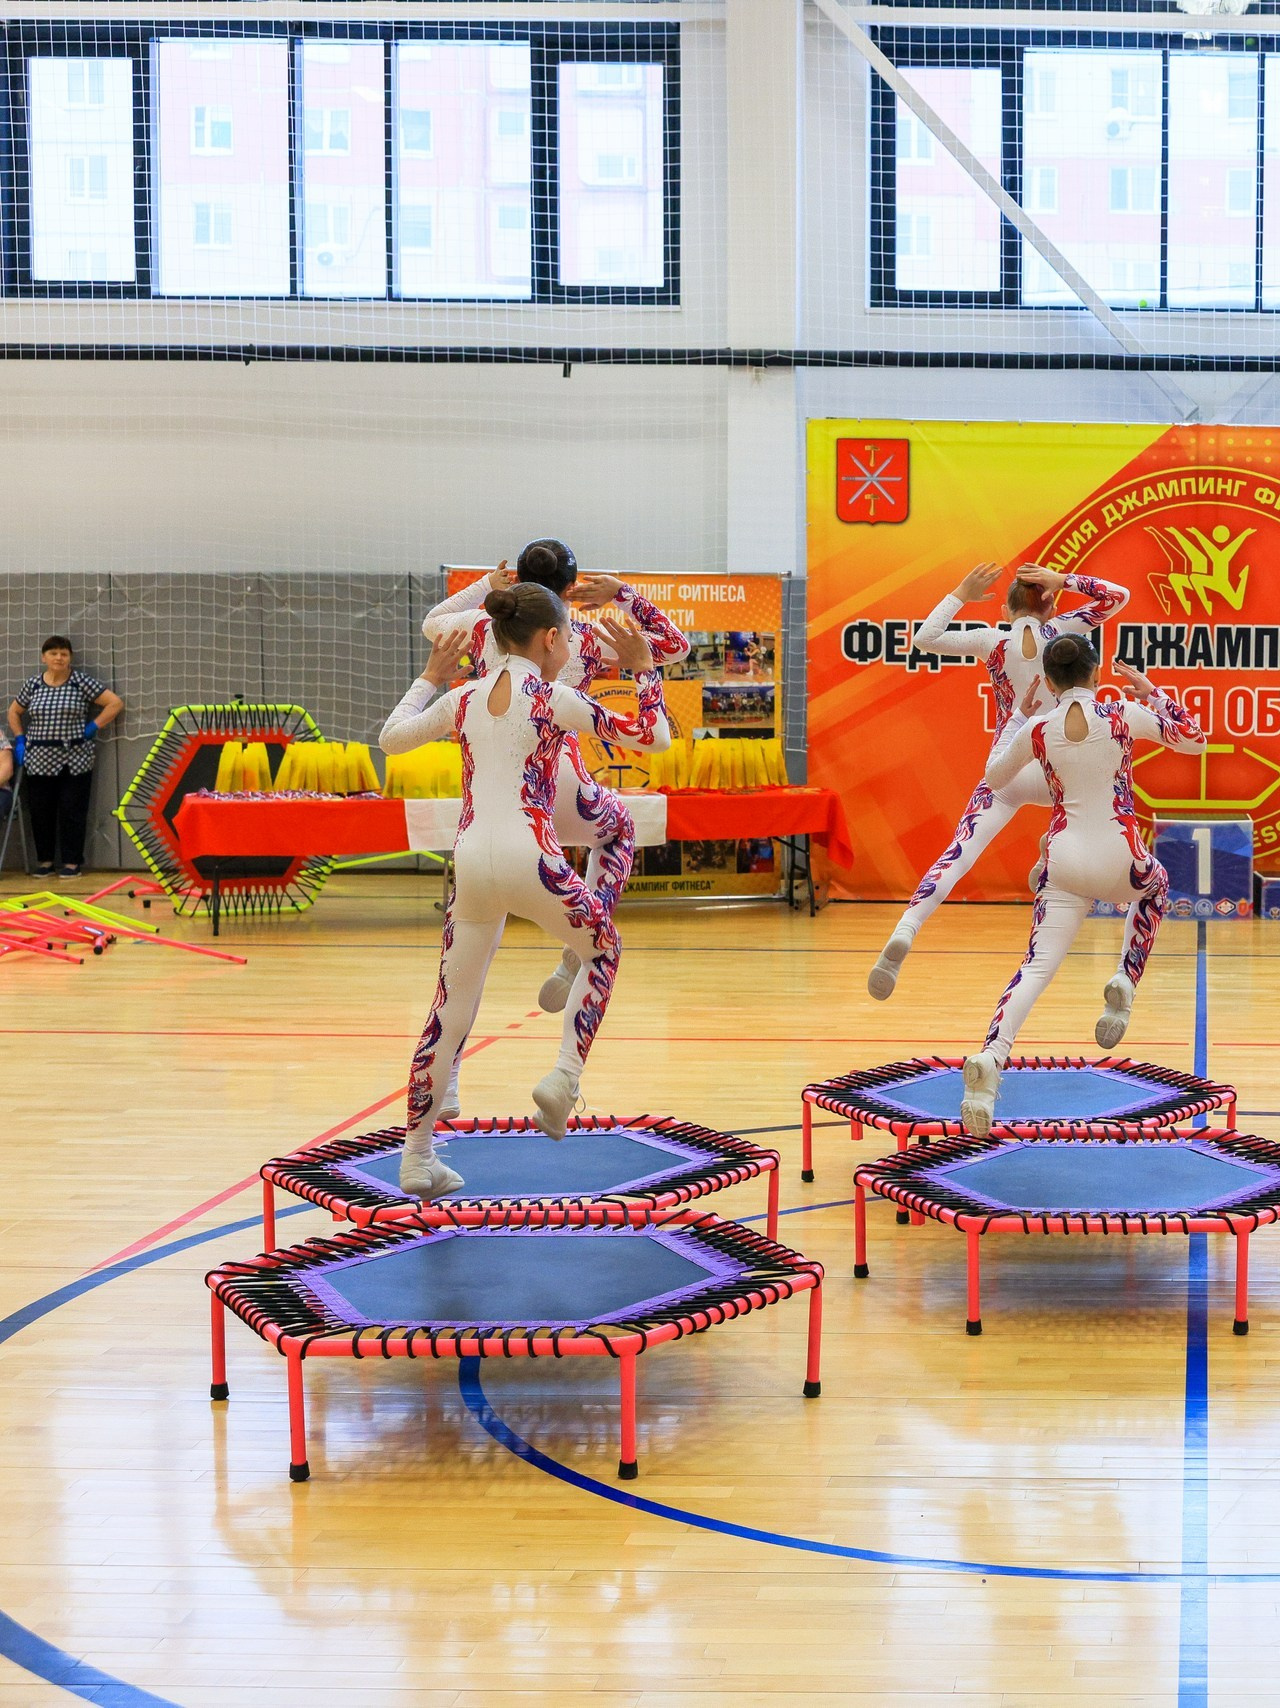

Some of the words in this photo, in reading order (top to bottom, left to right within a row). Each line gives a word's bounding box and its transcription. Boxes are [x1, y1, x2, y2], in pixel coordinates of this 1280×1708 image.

[1101, 476, 1248, 528] ДЖАМПИНГ
[678, 584, 746, 602] ФИТНЕСА
[593, 689, 633, 700] ЖАМПИНГ
[1192, 828, 1211, 895] 1
